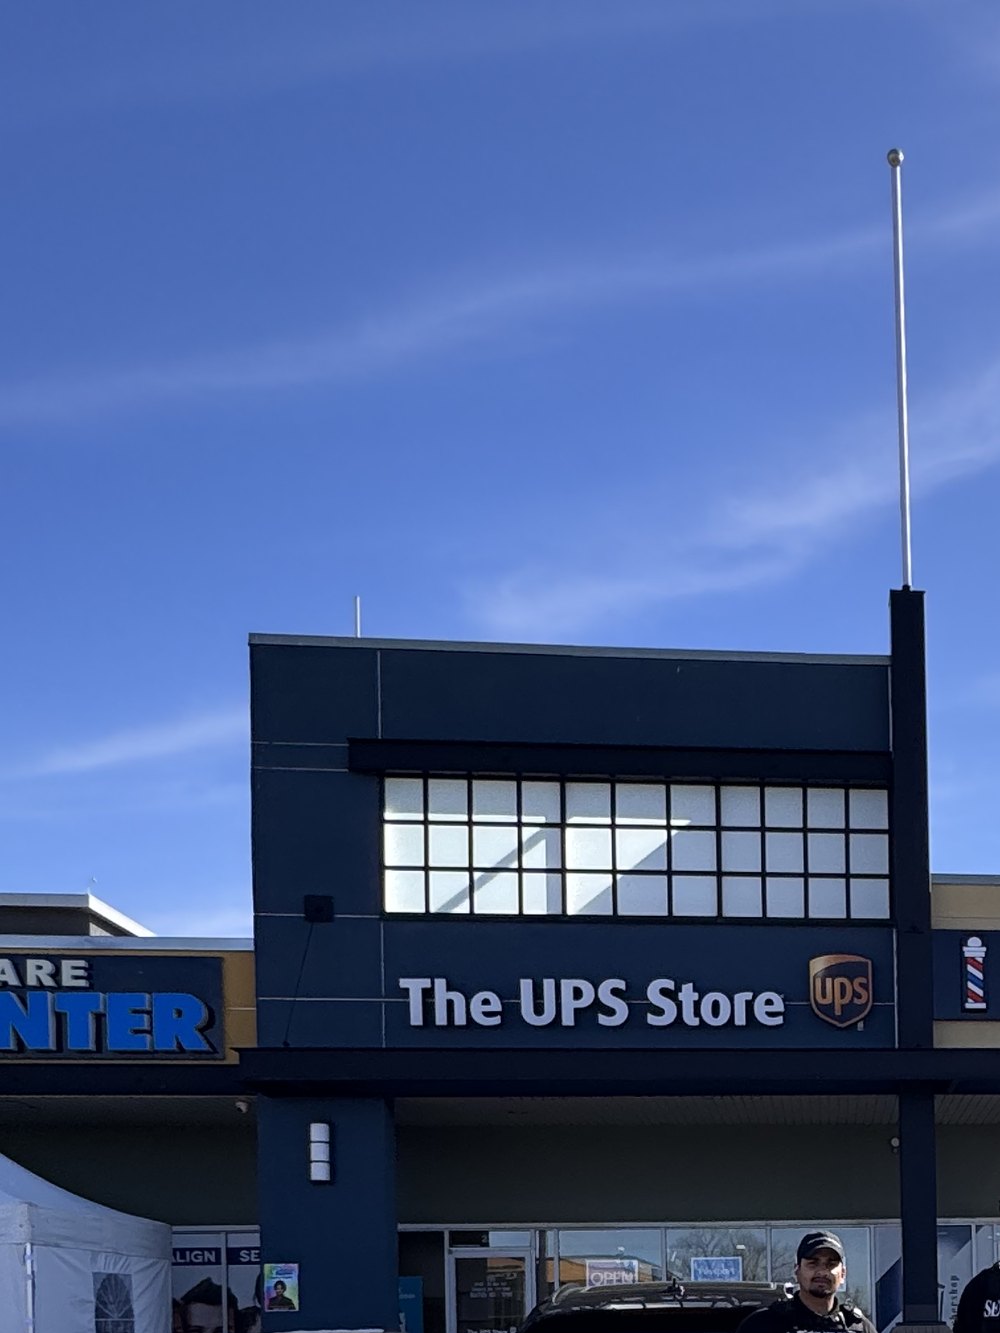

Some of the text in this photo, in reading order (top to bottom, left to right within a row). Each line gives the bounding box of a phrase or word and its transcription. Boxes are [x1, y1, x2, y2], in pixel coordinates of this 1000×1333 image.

[399, 978, 785, 1027] The UPS Store
[815, 976, 869, 1016] ups
